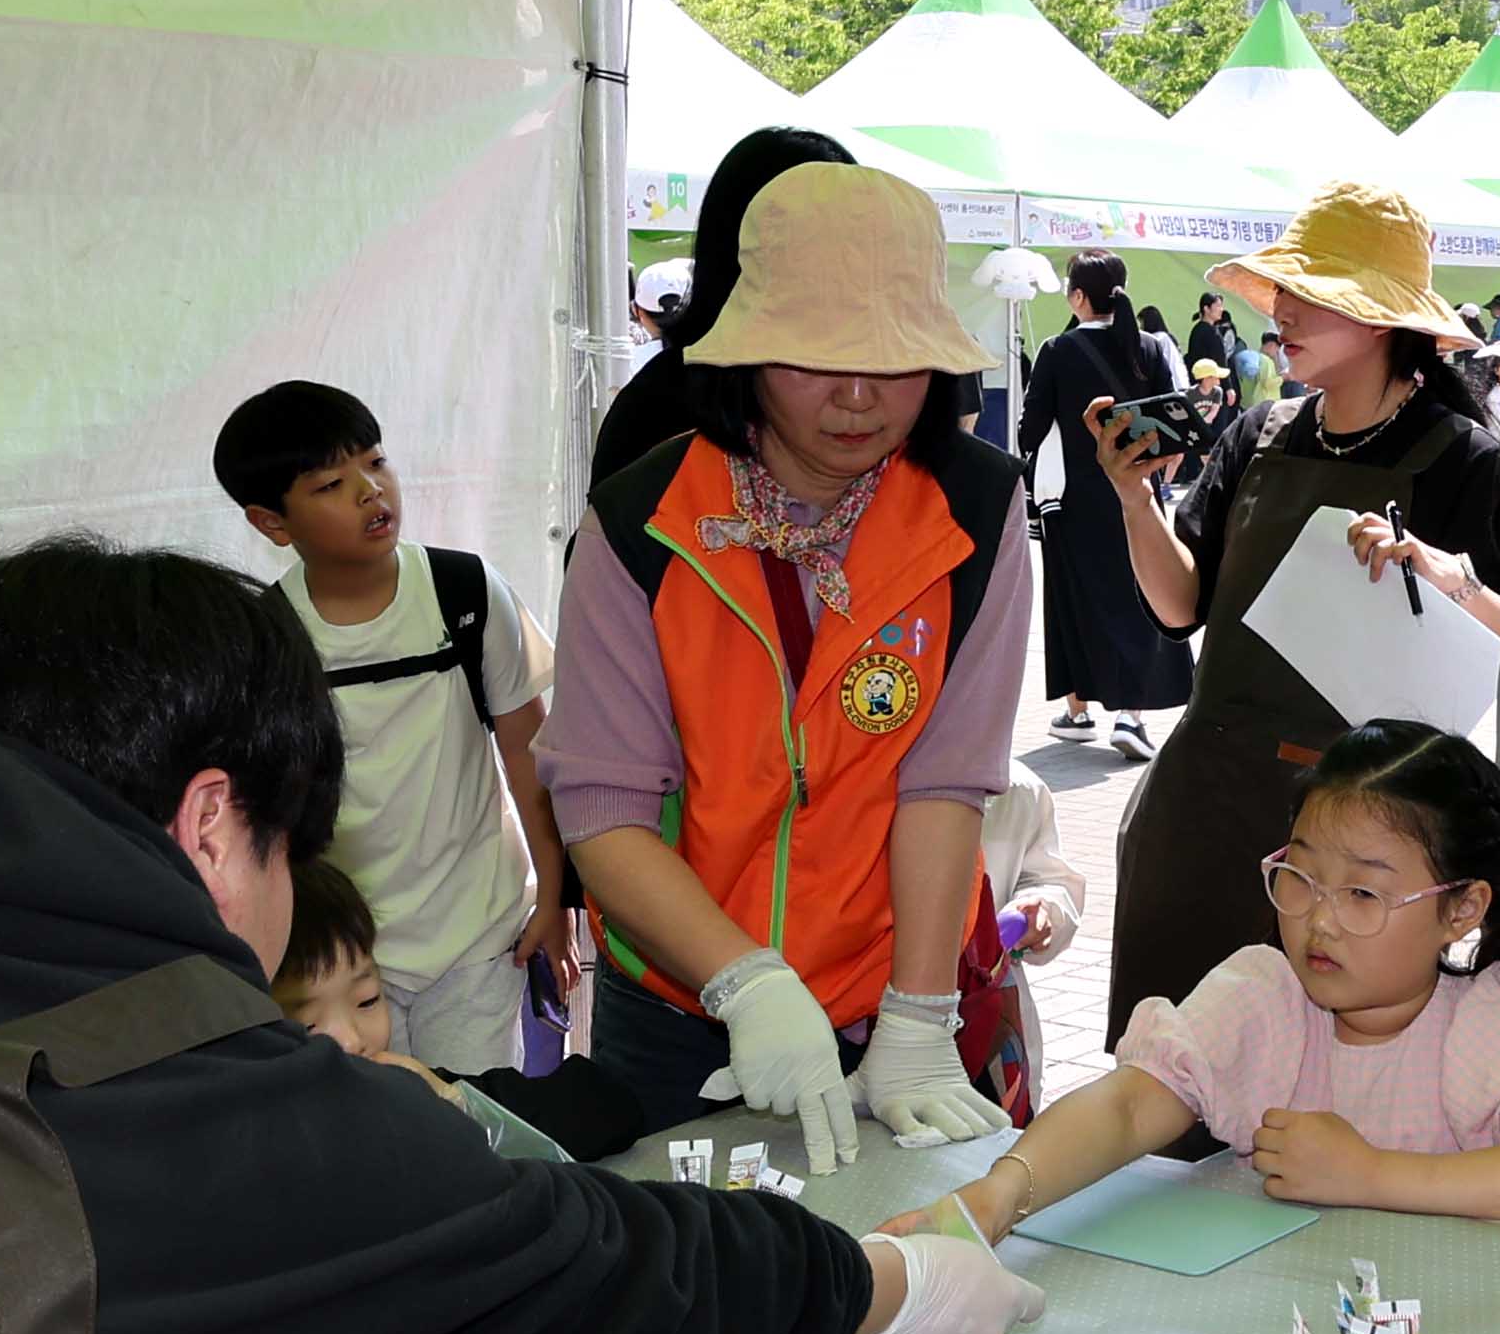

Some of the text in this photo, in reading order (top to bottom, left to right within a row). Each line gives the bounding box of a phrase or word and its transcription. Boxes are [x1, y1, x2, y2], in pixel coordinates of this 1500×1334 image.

[670, 181, 685, 197] 10
[1151, 215, 1186, 237] 나만의
[1188, 218, 1230, 240] 모루인형
[1232, 220, 1251, 242] 키링
